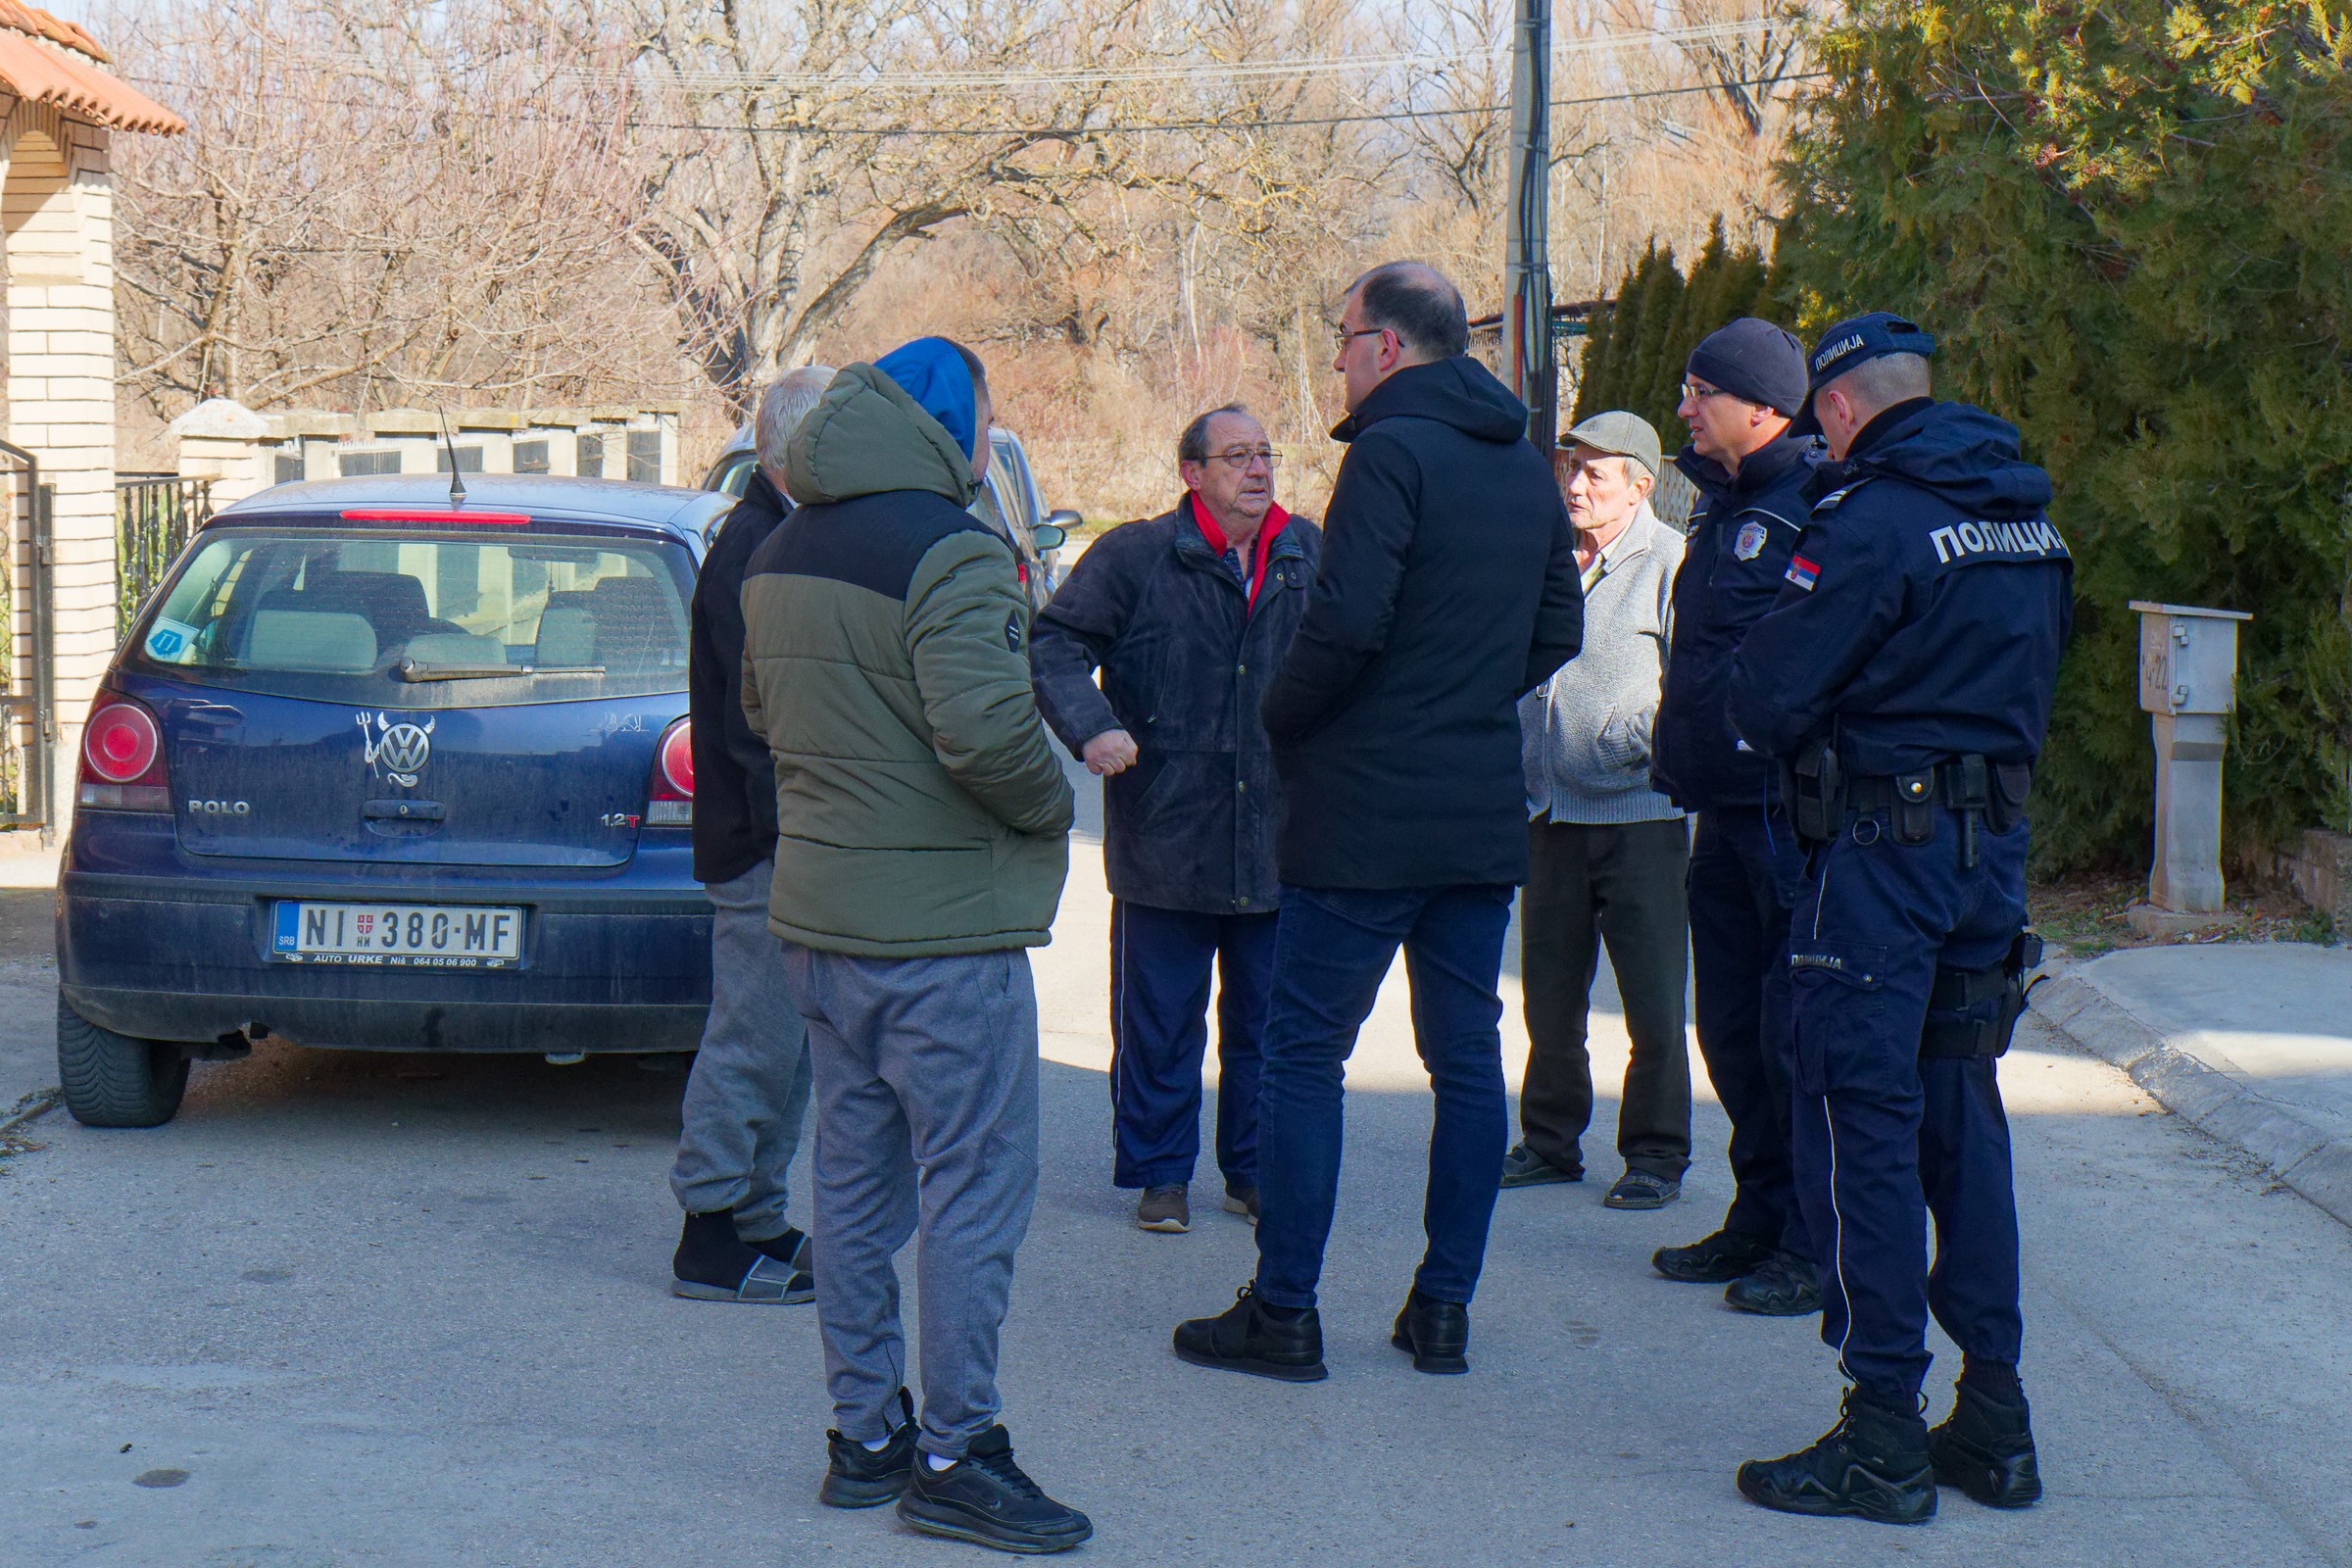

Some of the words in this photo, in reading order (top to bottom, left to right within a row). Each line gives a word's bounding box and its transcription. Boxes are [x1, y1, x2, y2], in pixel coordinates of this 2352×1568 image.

[1815, 333, 1865, 371] ПОЛИЦИЈА
[188, 800, 250, 814] POLO
[600, 812, 641, 828] 1.2T
[306, 909, 345, 947] NI
[278, 935, 295, 946] SRB
[314, 955, 342, 963] AUTO
[348, 955, 383, 964] URKE
[390, 956, 407, 965] Niš
[413, 957, 431, 966] 064
[446, 958, 458, 967] 06
[460, 958, 477, 967] 900
